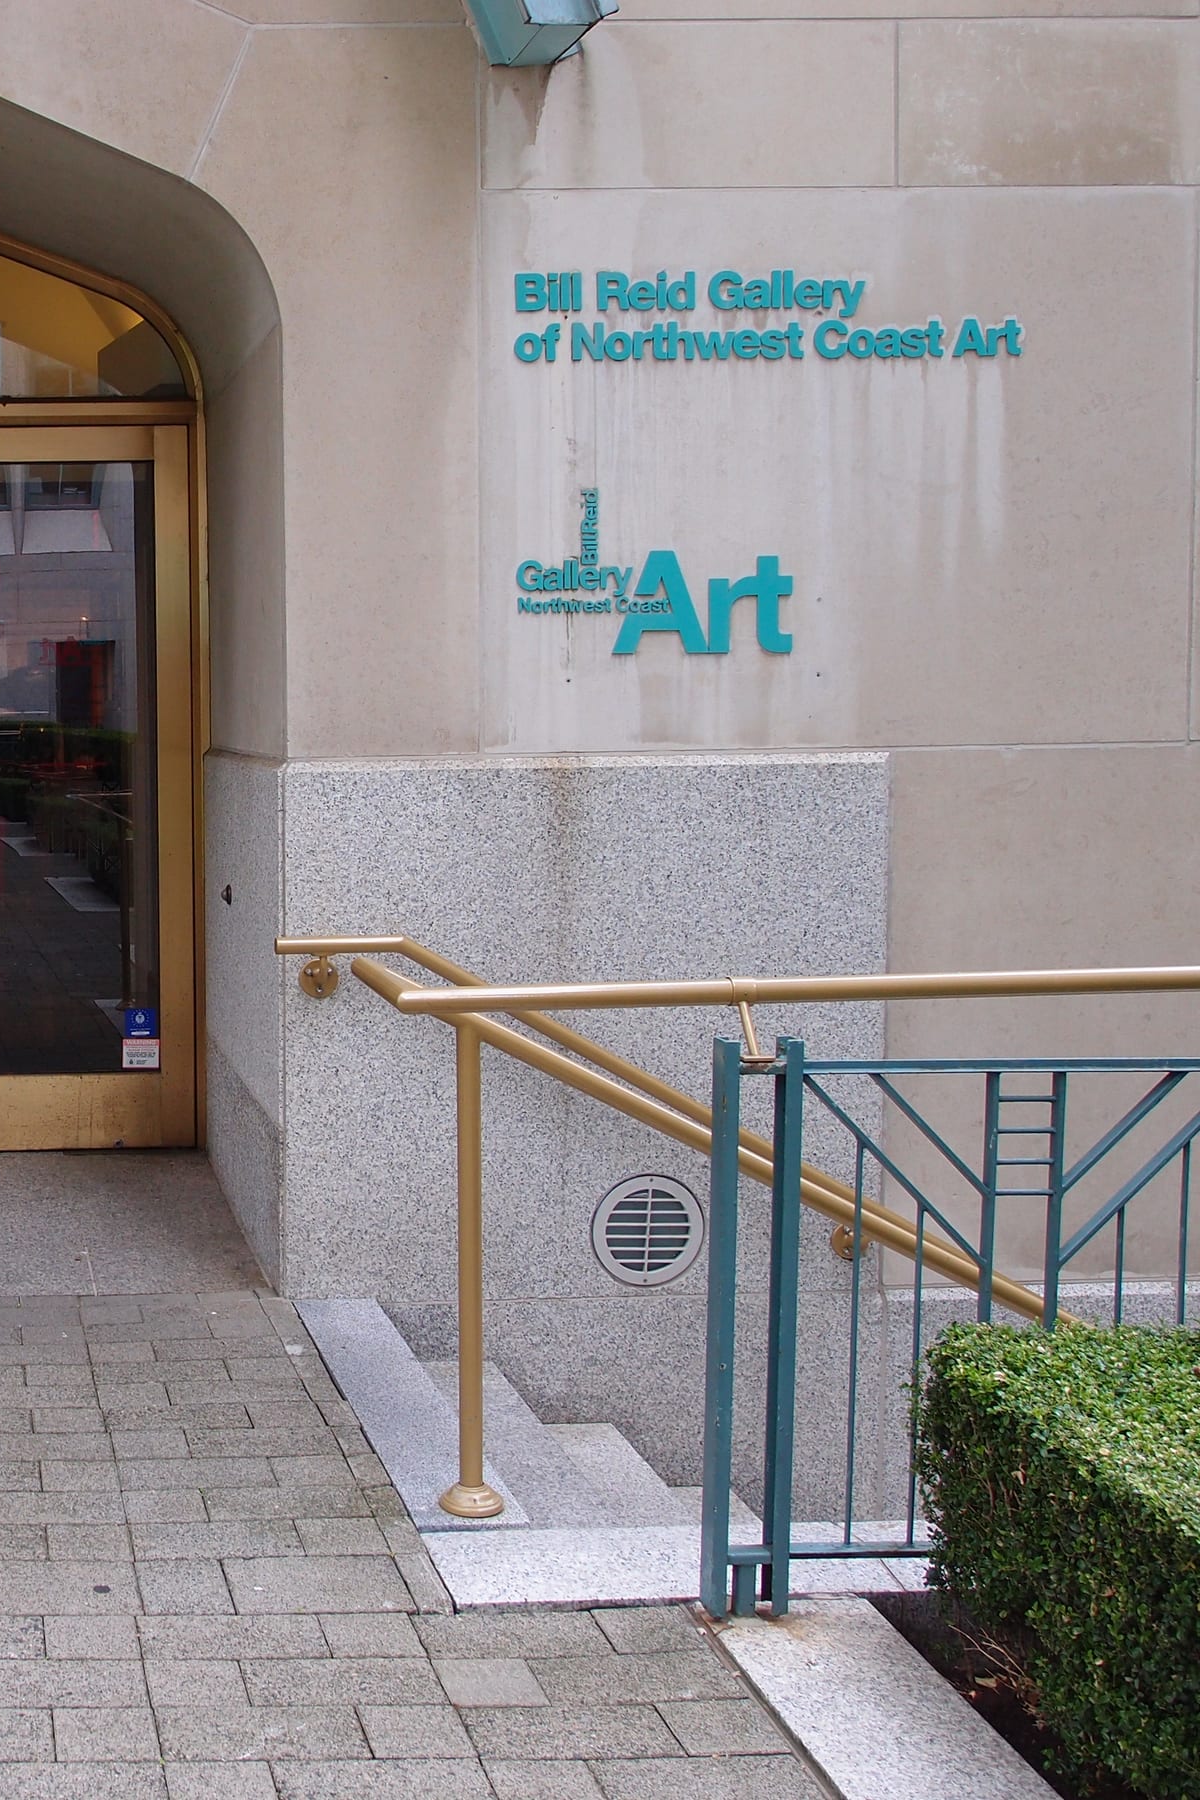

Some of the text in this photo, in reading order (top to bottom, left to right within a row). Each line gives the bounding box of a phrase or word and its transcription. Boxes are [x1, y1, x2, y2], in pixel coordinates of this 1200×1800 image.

[515, 270, 866, 317] Bill Reid Gallery
[514, 318, 1023, 362] of Northwest Coast Art
[516, 559, 633, 597] Gallery
[518, 596, 671, 614] Northwest Coast
[612, 550, 793, 655] Art
